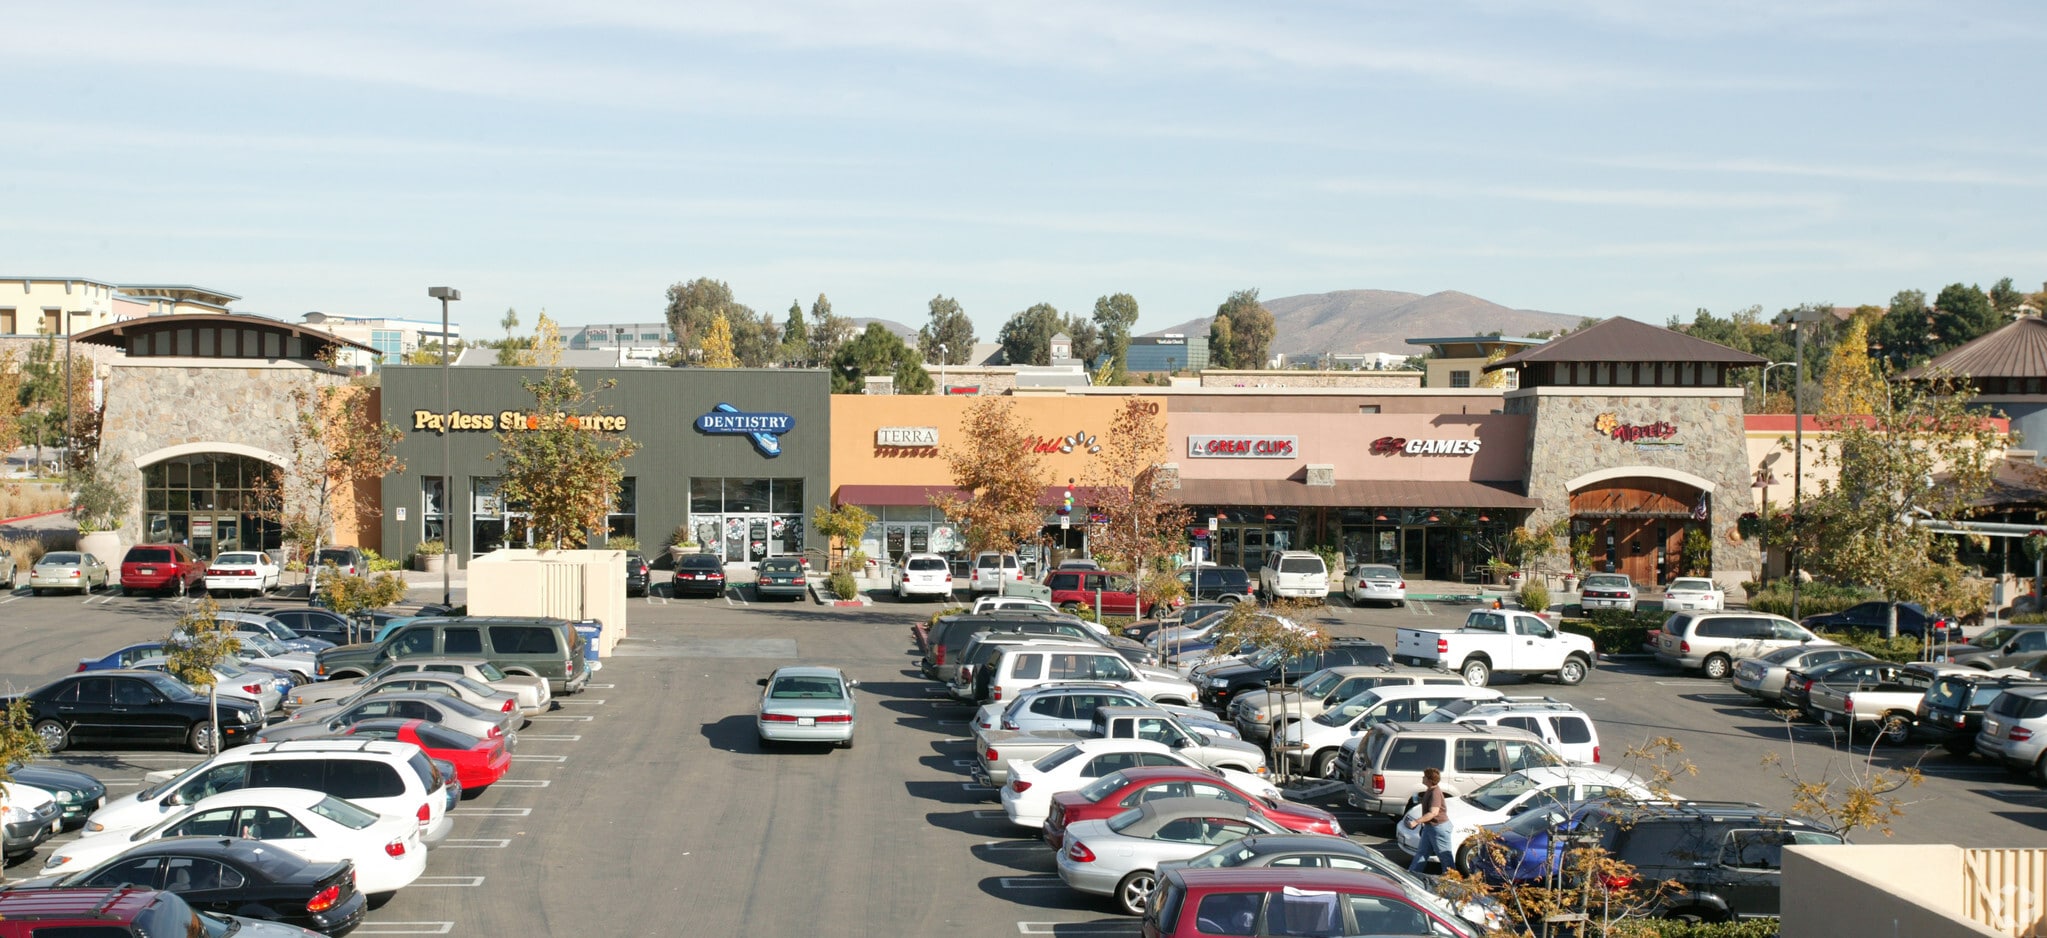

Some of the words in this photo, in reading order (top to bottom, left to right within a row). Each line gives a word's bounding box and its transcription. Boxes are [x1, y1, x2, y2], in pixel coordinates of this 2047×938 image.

[415, 410, 494, 432] Payless
[704, 416, 788, 428] DENTISTRY
[881, 430, 935, 442] TERRA
[1207, 440, 1252, 453] GREAT
[1256, 440, 1293, 453] CLIPS
[1405, 439, 1481, 454] GAMES
